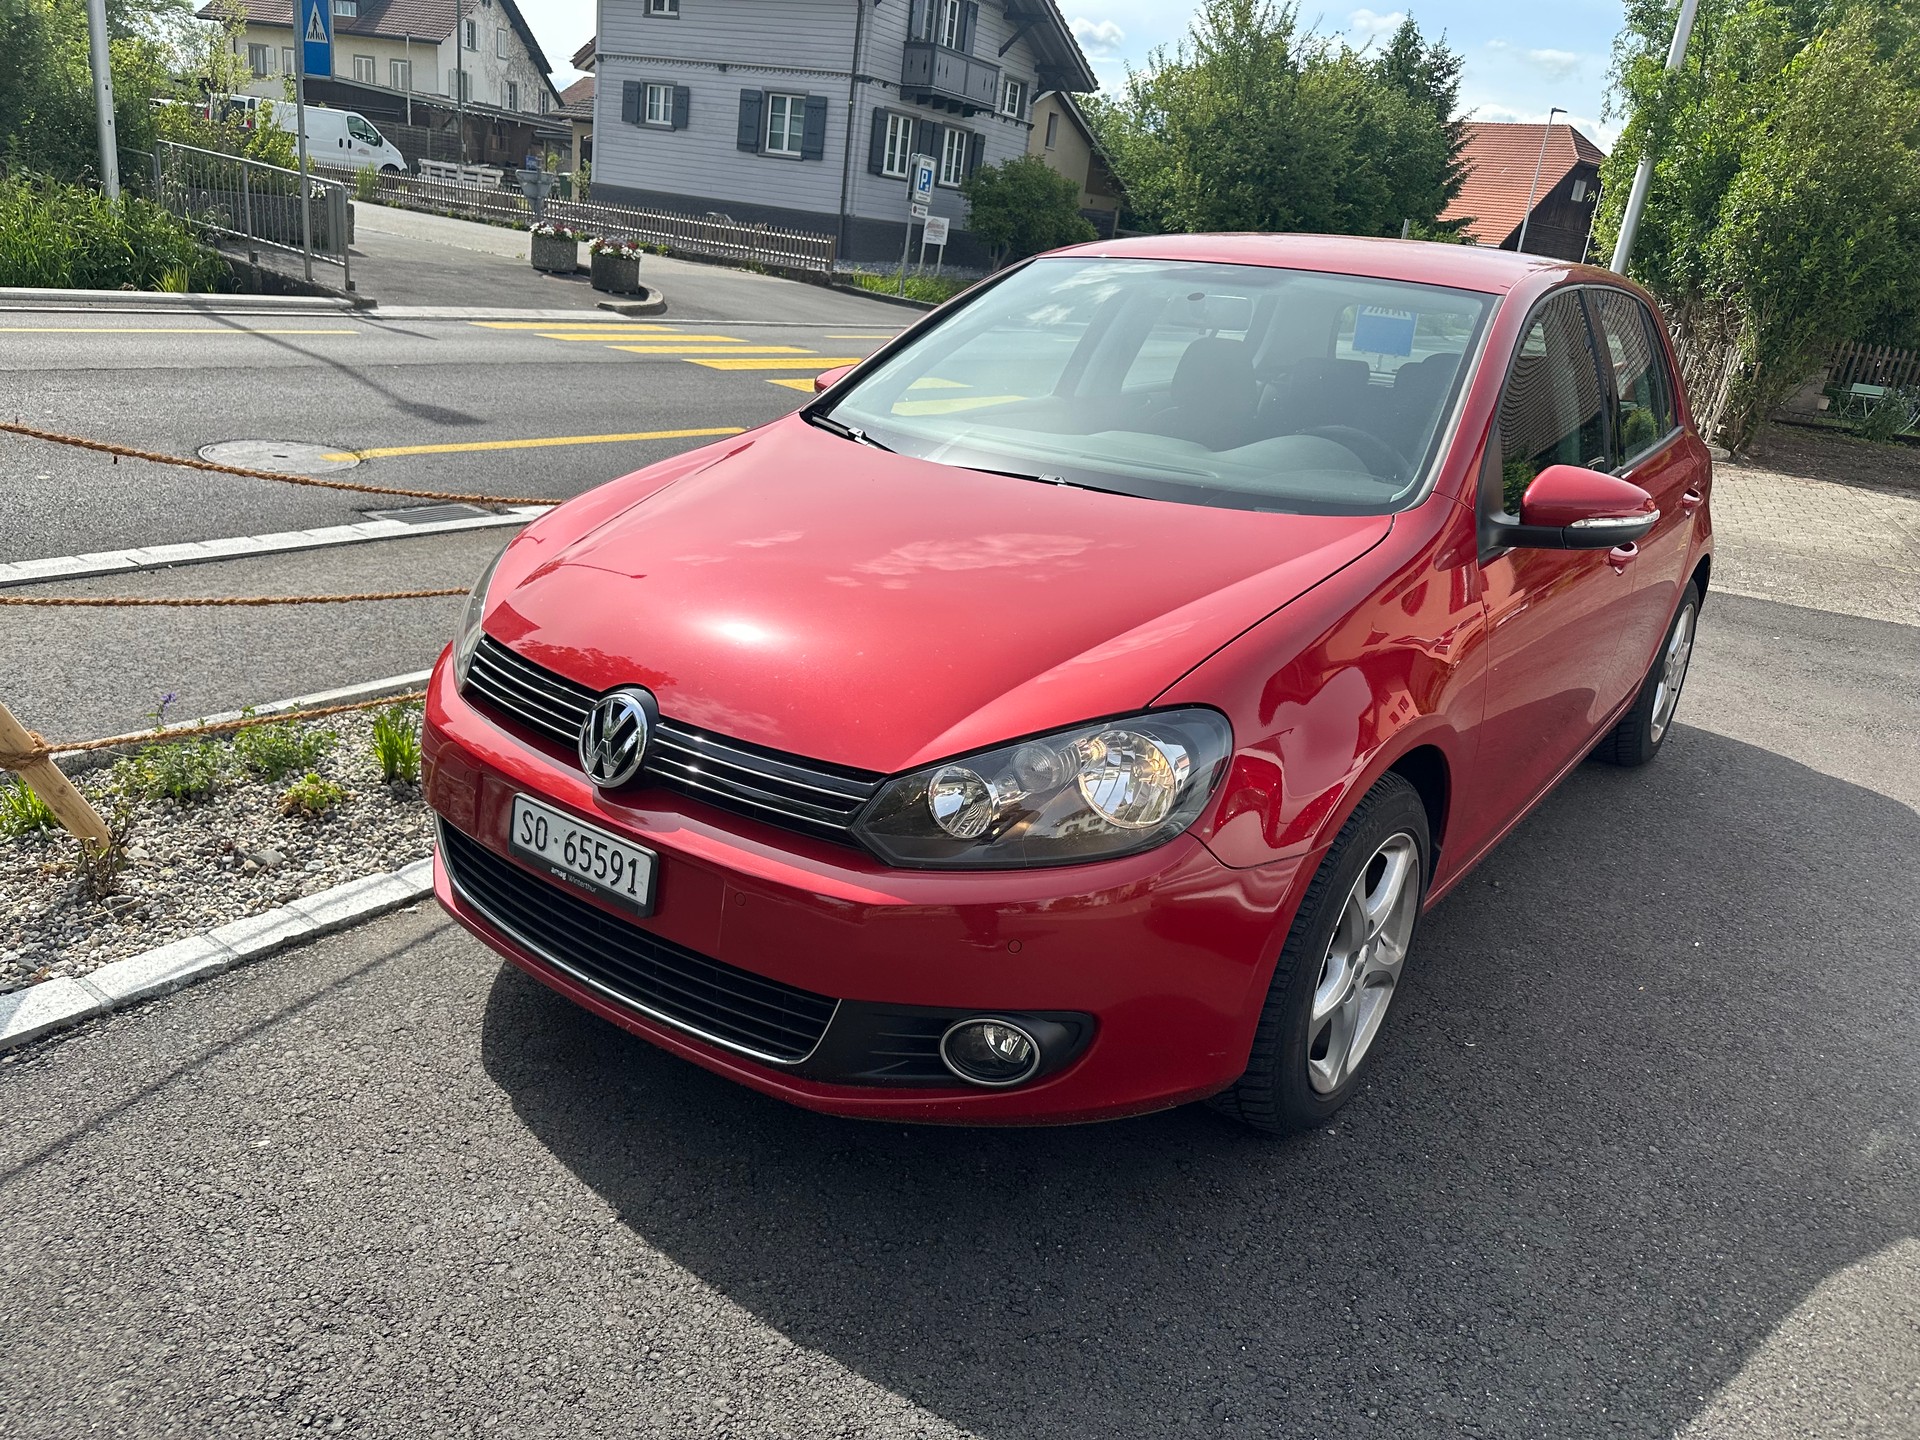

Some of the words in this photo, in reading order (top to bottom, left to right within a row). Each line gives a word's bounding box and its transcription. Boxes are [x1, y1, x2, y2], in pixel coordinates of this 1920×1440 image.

[920, 170, 929, 189] P
[583, 696, 644, 783] VW
[520, 809, 548, 851] SO
[563, 830, 640, 897] 65591
